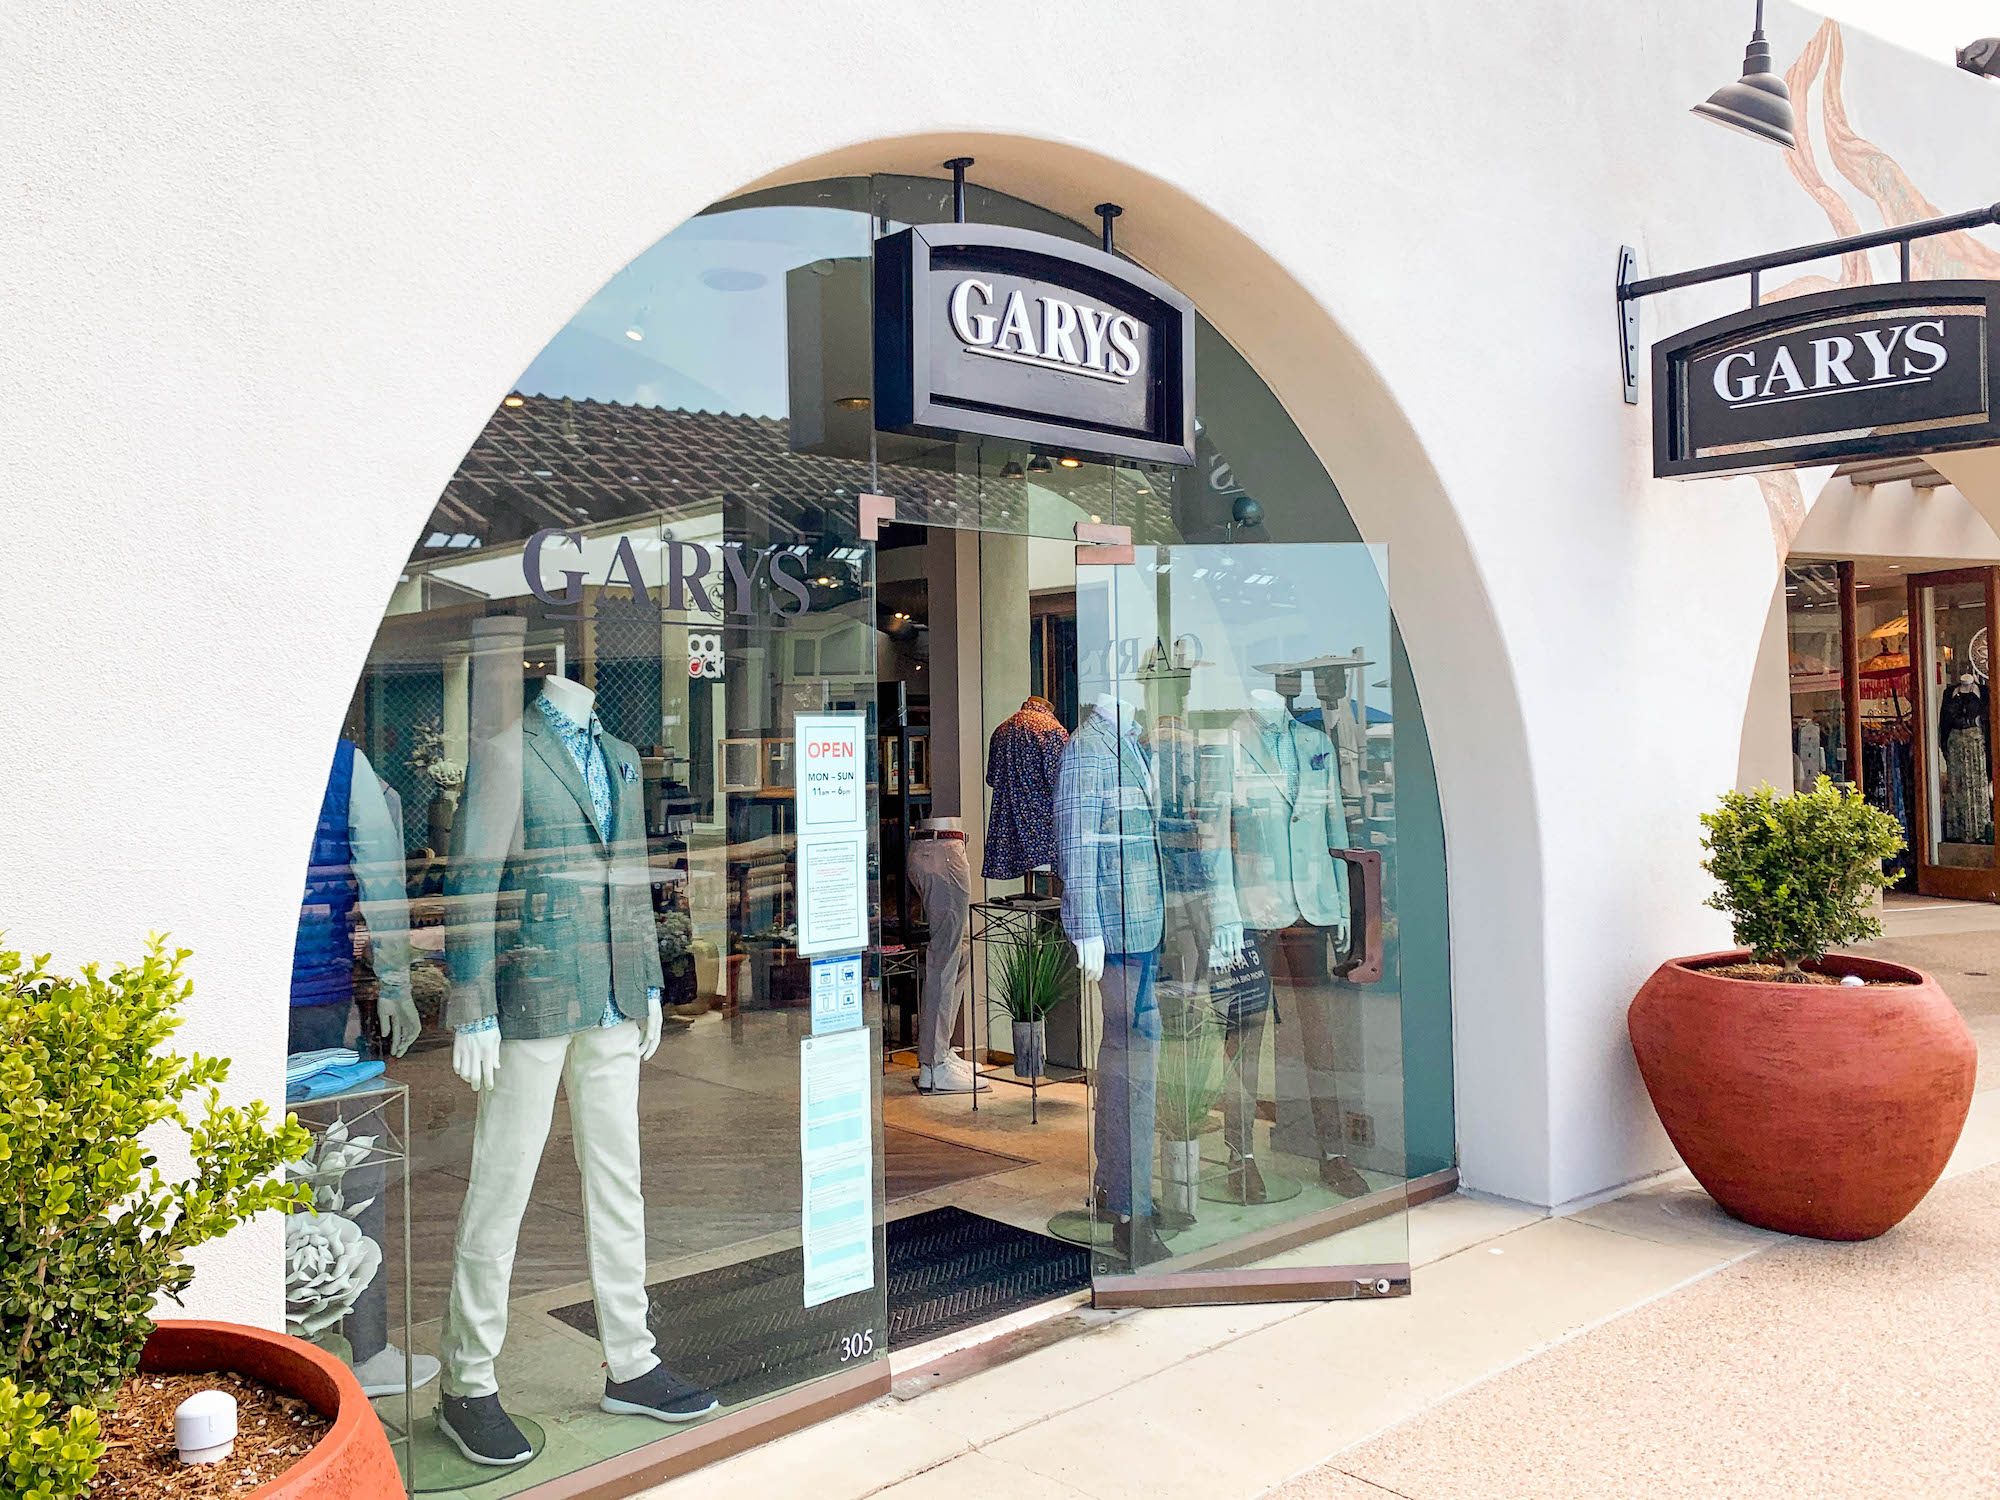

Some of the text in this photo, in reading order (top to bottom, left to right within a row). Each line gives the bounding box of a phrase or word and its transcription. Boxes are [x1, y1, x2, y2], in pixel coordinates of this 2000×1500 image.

[951, 279, 1141, 377] GARYS
[1713, 320, 1949, 402] GARYS
[523, 528, 811, 618] GARYS
[808, 742, 854, 758] OPEN
[808, 772, 829, 782] MON
[838, 771, 854, 781] SUN
[840, 1328, 873, 1364] 305
